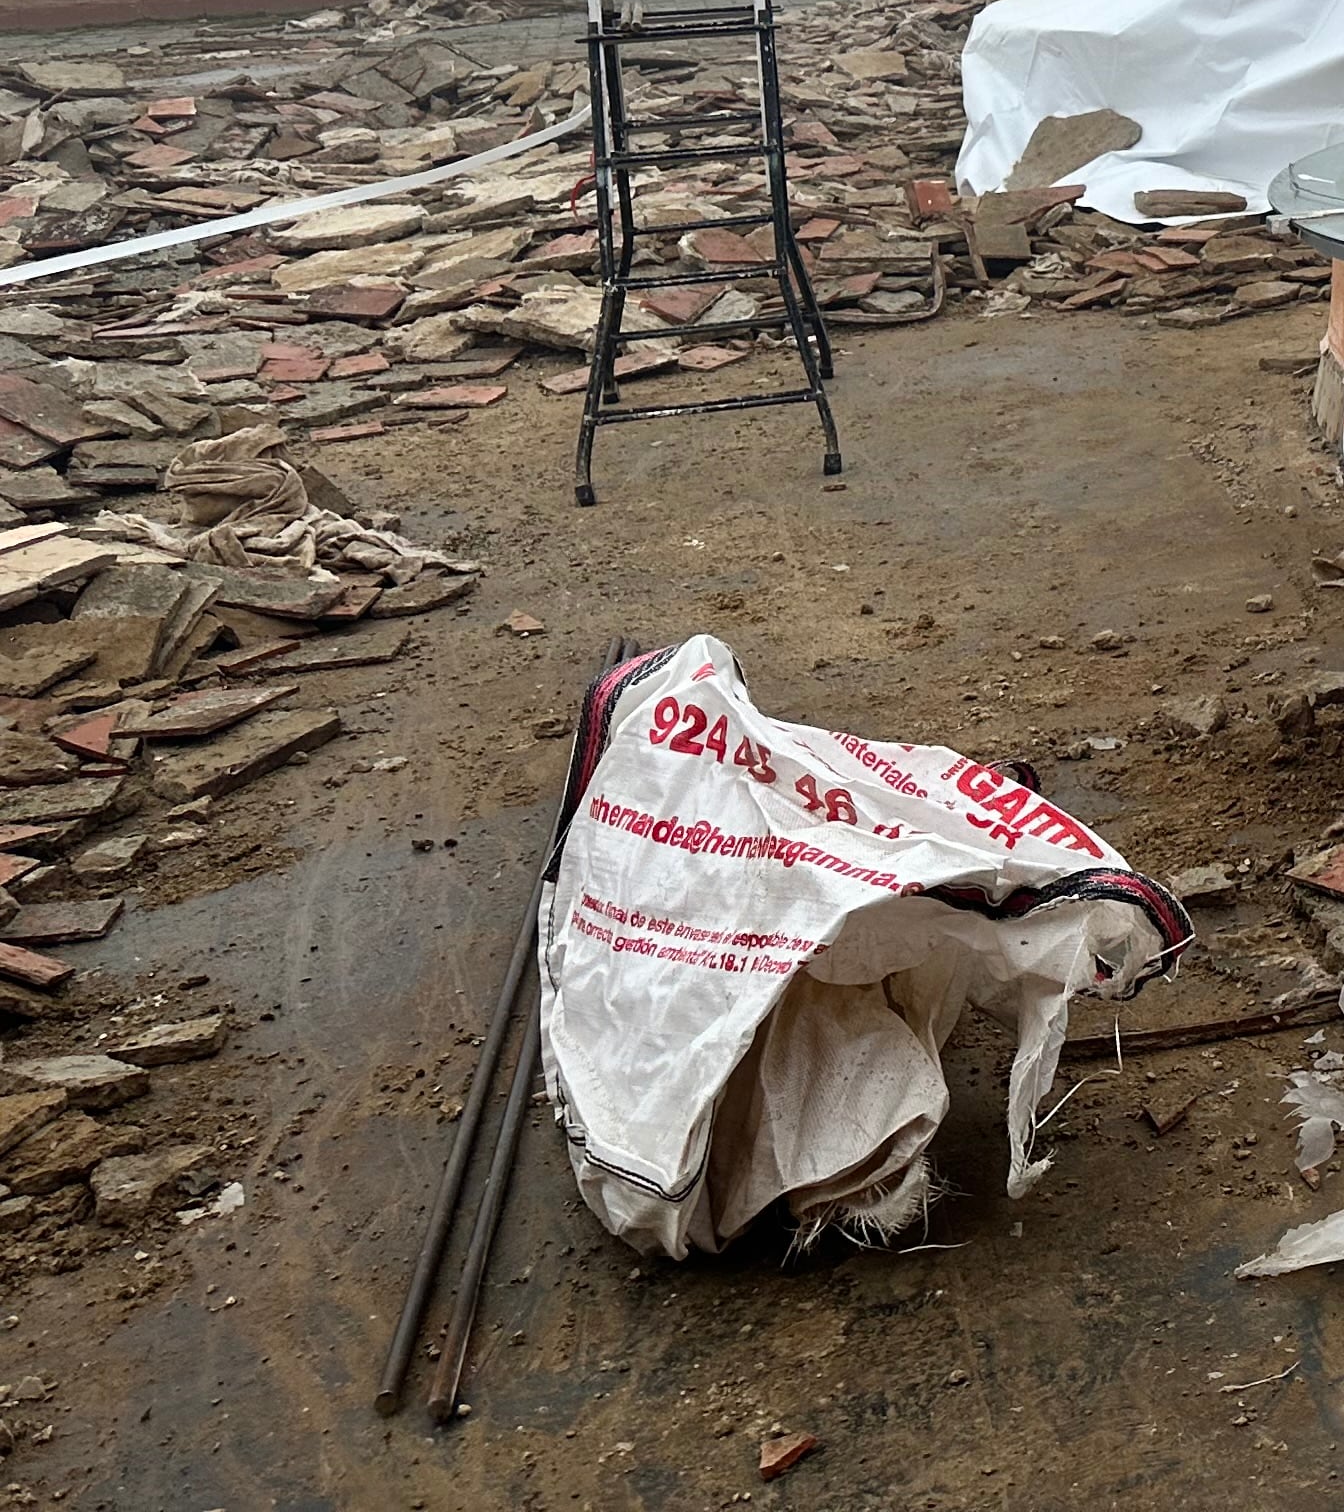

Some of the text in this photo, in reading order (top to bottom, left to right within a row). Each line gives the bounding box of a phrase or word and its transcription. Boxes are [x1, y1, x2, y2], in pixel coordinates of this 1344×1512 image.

[649, 696, 857, 826] 924 45 46
